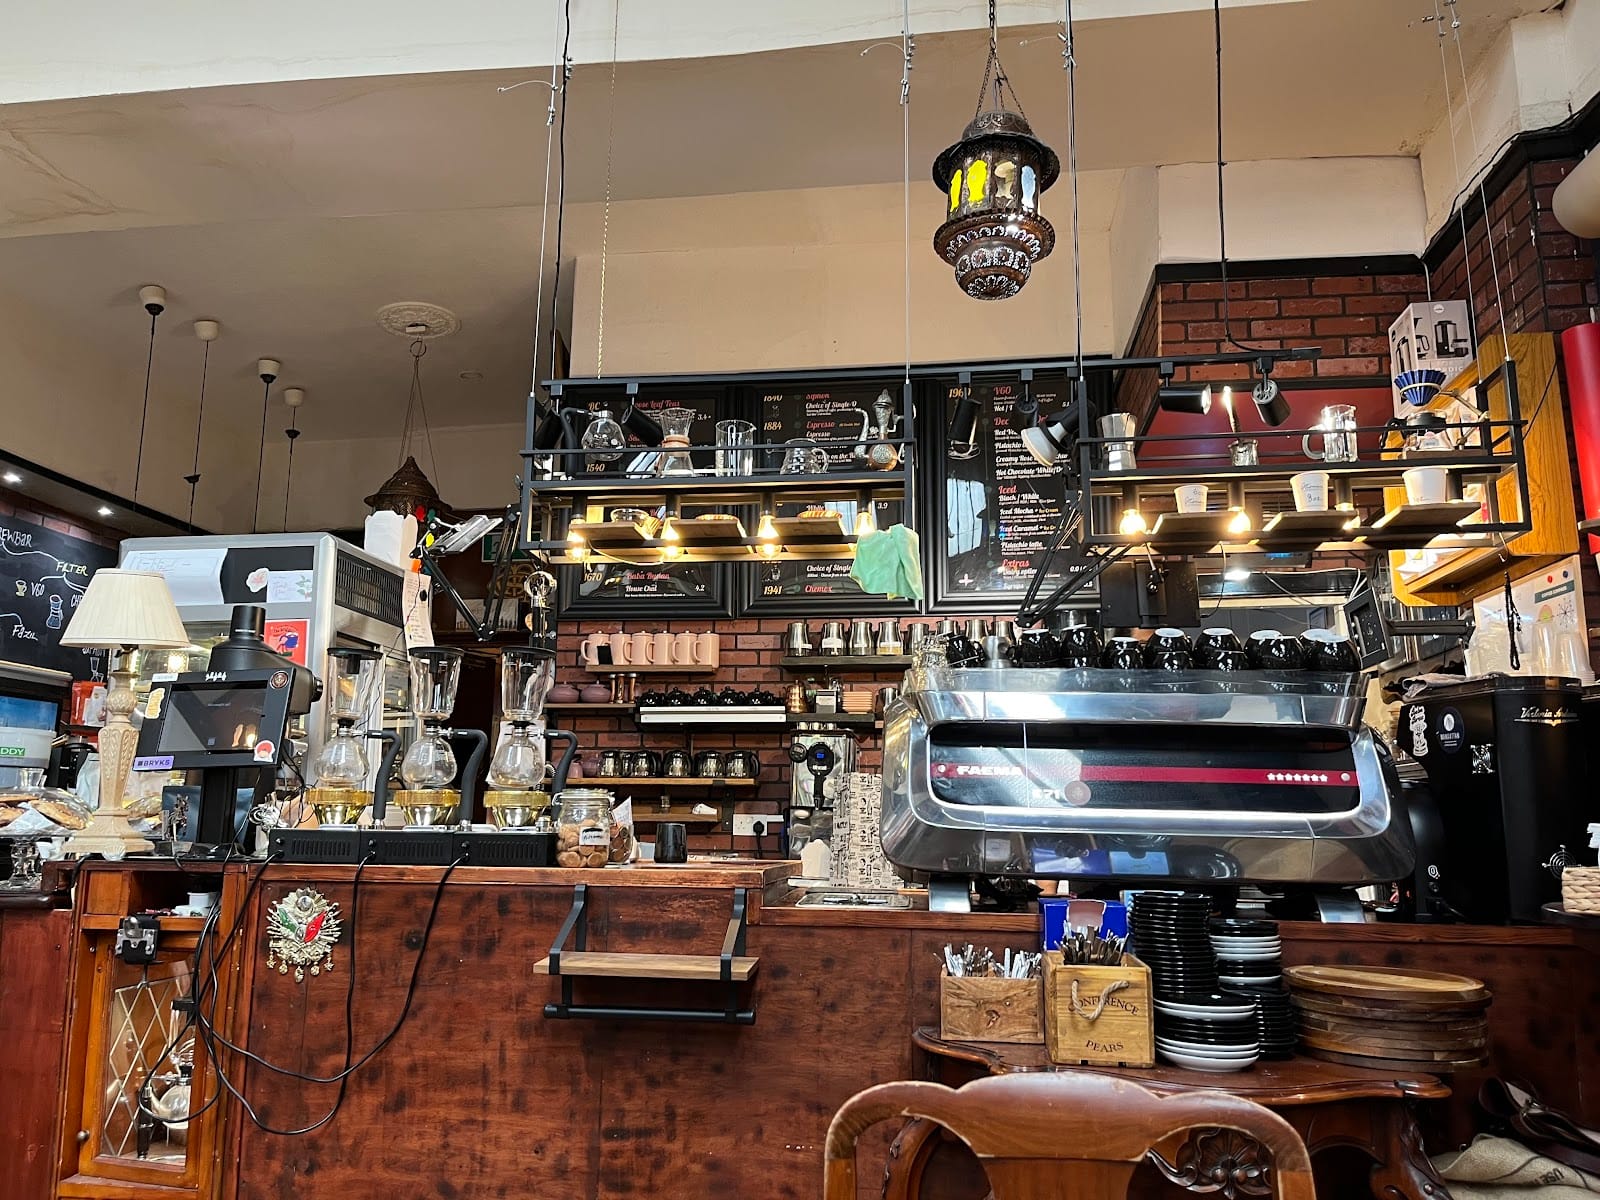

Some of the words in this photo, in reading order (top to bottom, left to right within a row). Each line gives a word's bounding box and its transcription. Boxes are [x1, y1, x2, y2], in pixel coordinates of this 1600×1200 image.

[763, 421, 782, 431] 1884
[806, 421, 835, 430] Espresso
[806, 431, 831, 439] Espresso
[996, 455, 1018, 463] Creamy
[1007, 467, 1035, 475] Chocolate
[998, 485, 1017, 494] Iced
[1002, 558, 1030, 568] Extras
[807, 564, 825, 572] Choice
[826, 564, 832, 572] of
[583, 572, 602, 582] 1670
[763, 585, 782, 595] 1941
[805, 585, 832, 593] Chemex
[957, 765, 1024, 776] FAEMA
[1068, 995, 1140, 1016] CNFRENCE
[1086, 1039, 1124, 1053] PEARS
